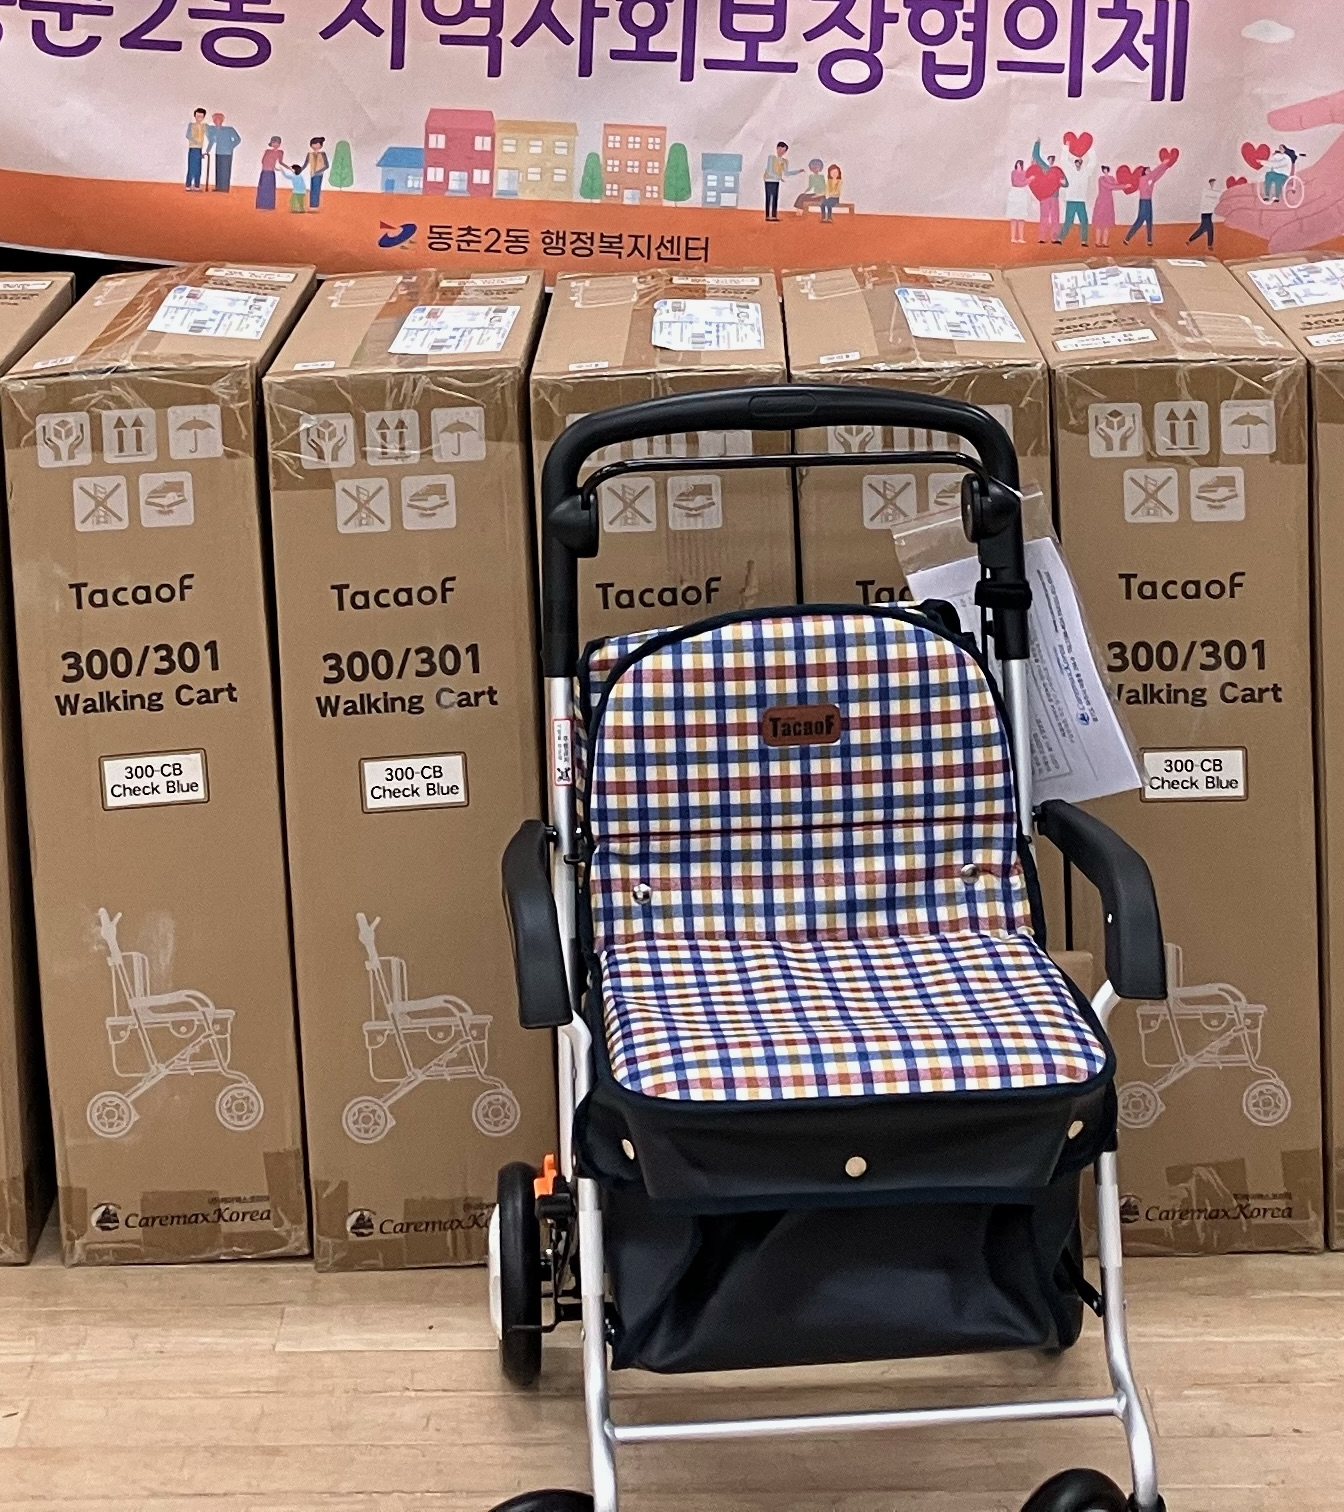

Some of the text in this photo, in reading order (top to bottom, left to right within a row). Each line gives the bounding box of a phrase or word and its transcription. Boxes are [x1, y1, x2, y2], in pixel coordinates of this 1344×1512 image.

[427, 225, 710, 263] 동춘2동 행정복지센터
[60, 640, 220, 682] 300/301
[322, 643, 480, 685] 300/301
[1106, 639, 1266, 673] 300/301
[54, 682, 238, 717] Walking Cart
[315, 686, 498, 718] Walking Cart
[1219, 681, 1283, 704] Cart
[124, 763, 183, 779] 300-CB
[384, 766, 443, 781] 300-CB
[1163, 757, 1223, 773] 300-CB
[110, 779, 200, 798] Check Blue
[370, 782, 460, 800] Check Blue
[1149, 774, 1239, 790] Check Blue
